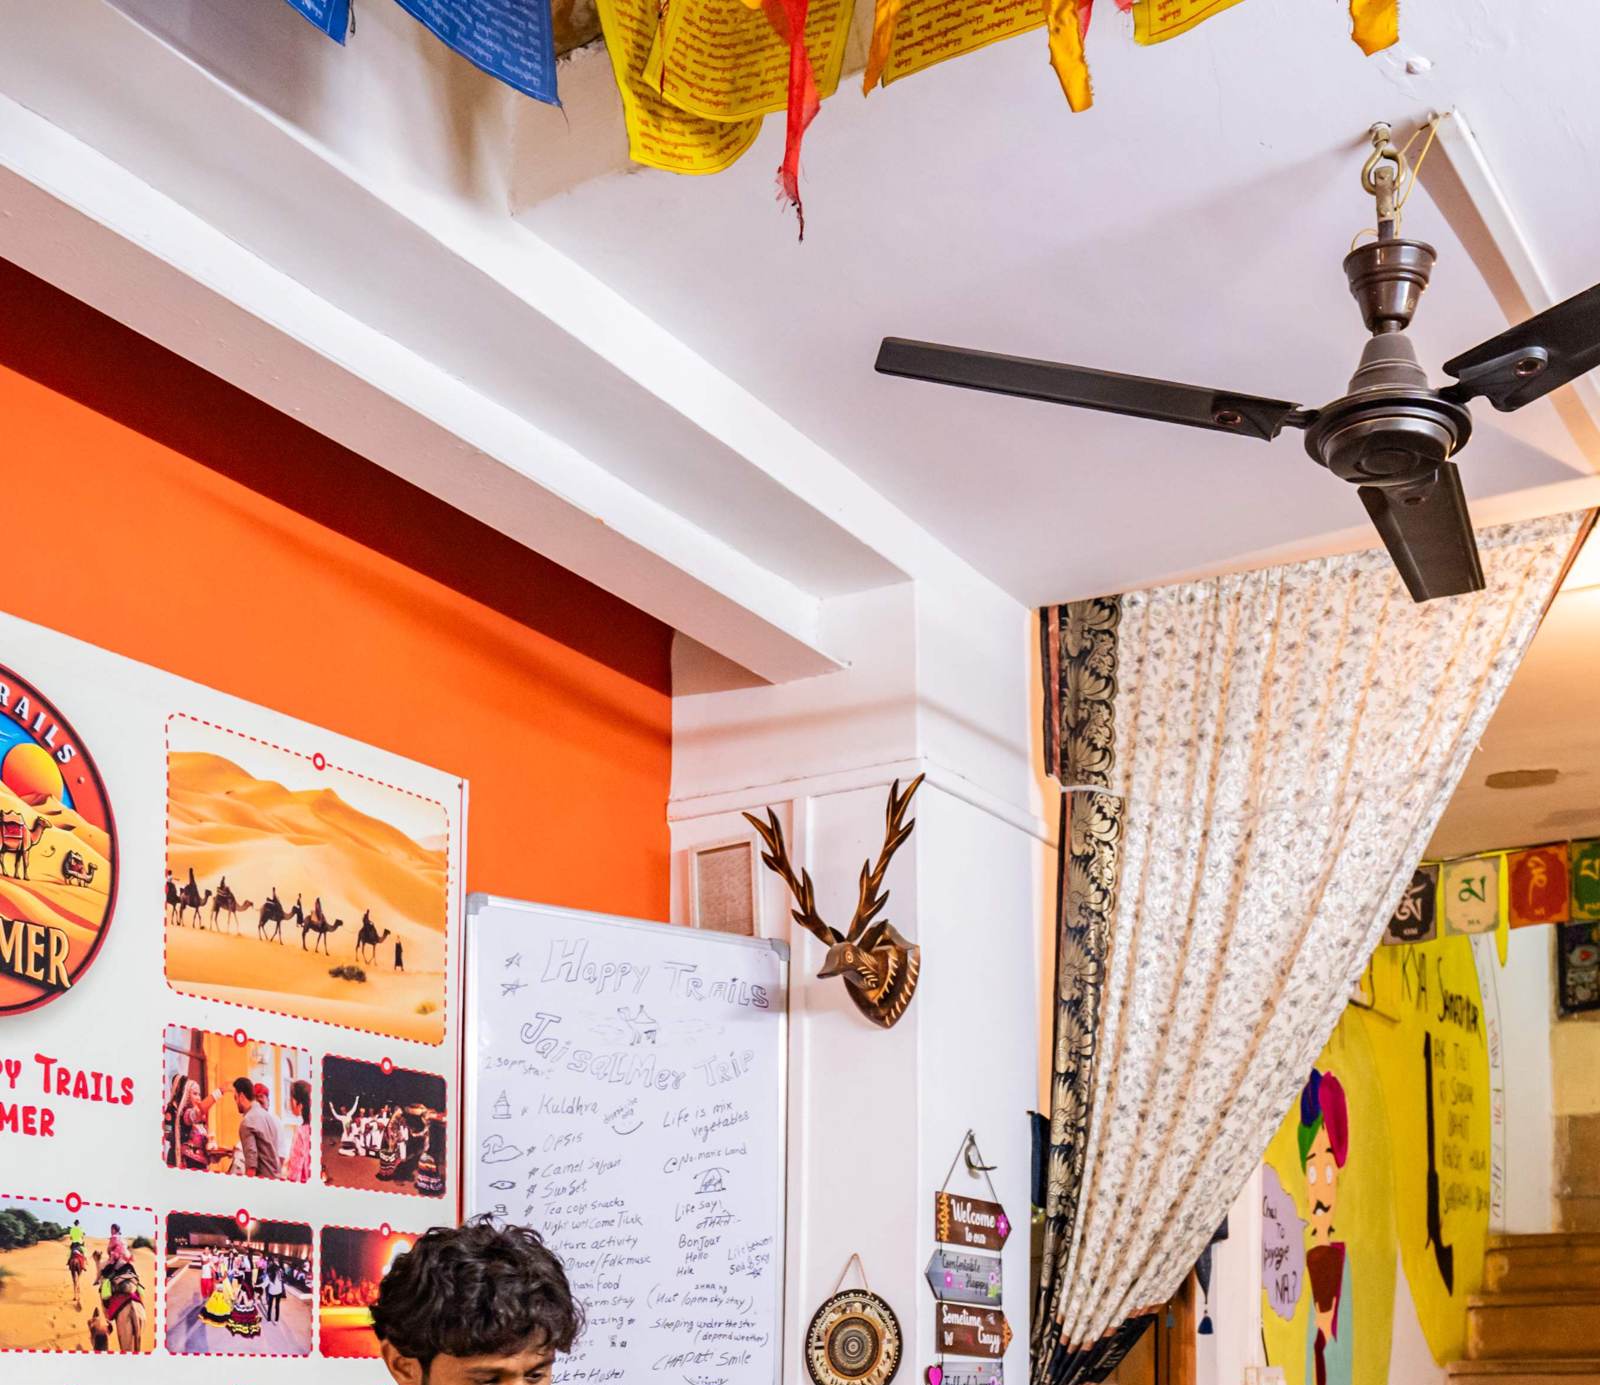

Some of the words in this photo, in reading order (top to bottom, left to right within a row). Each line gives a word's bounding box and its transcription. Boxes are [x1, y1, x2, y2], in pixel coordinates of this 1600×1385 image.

[541, 936, 650, 996] Happy
[0, 1058, 22, 1090] Y
[951, 1198, 996, 1229] Welcome
[551, 1370, 571, 1385] ack
